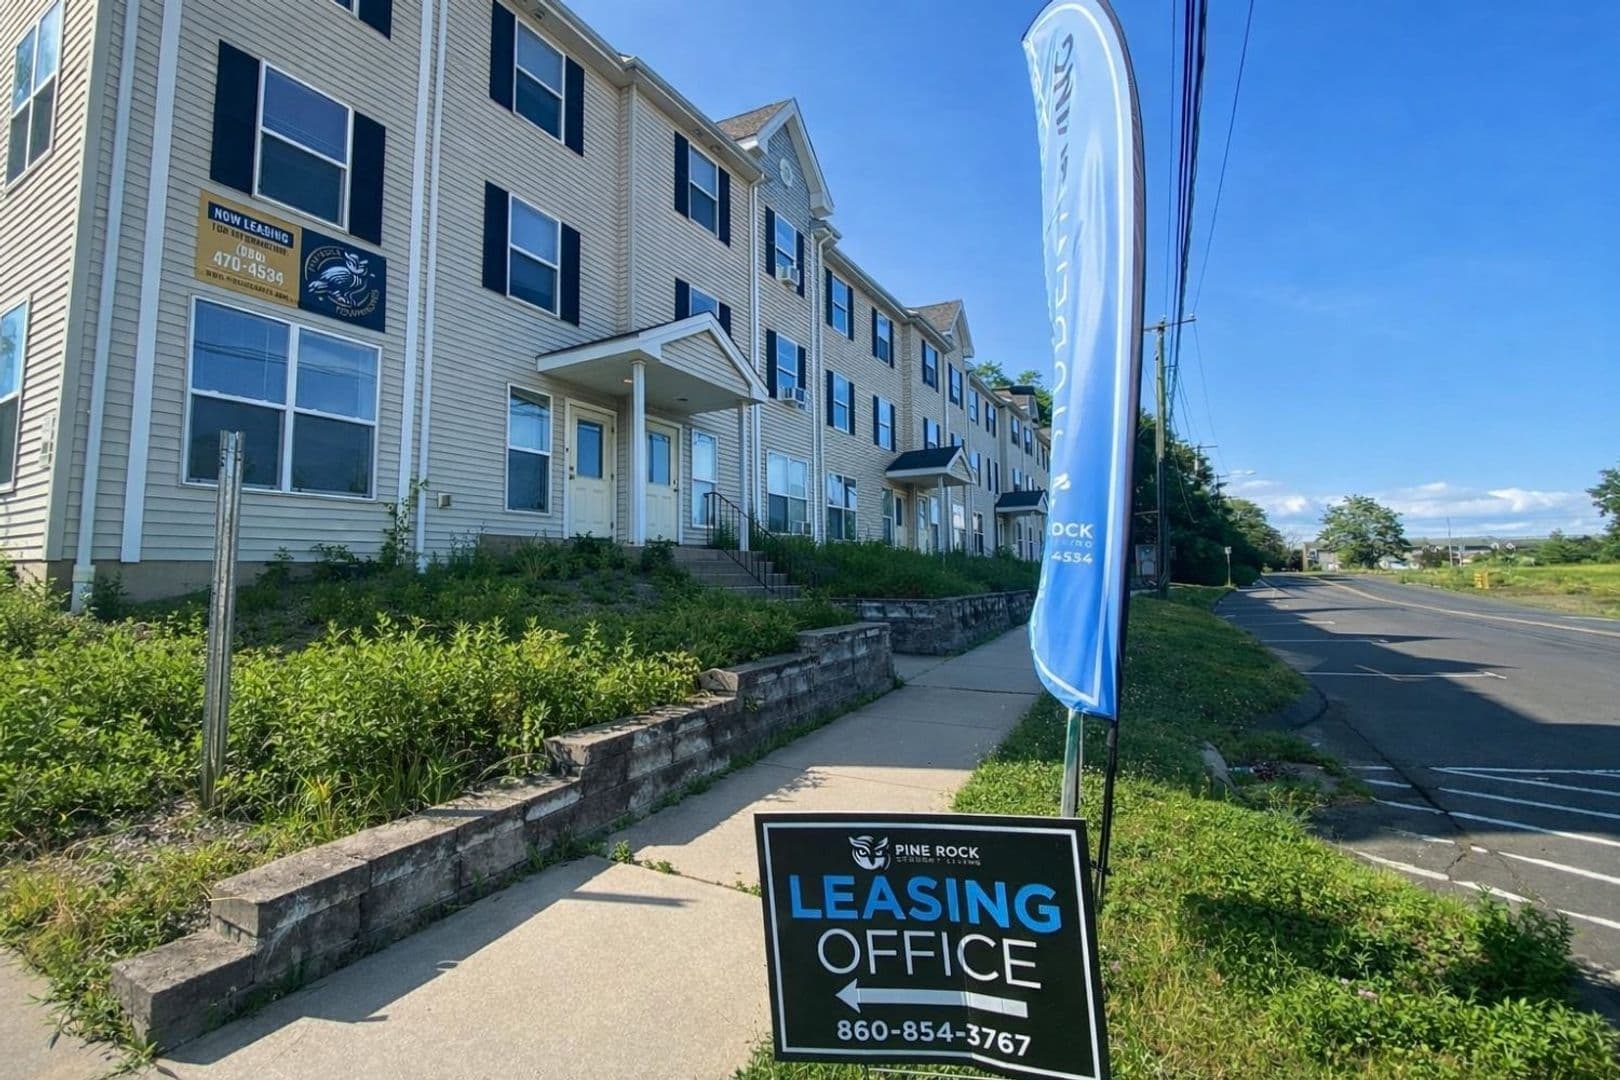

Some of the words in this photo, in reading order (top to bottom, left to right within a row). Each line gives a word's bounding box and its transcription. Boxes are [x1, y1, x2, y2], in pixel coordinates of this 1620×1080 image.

[214, 207, 241, 226] NOW
[244, 218, 289, 244] LEASING
[213, 250, 284, 286] 470-4534
[1051, 521, 1095, 539] OCK
[895, 843, 931, 857] PINE
[936, 844, 980, 859] ROCK
[789, 874, 1062, 935] LEASING
[817, 928, 1041, 990] OFFICE
[837, 1019, 1032, 1058] 860-854-3767
